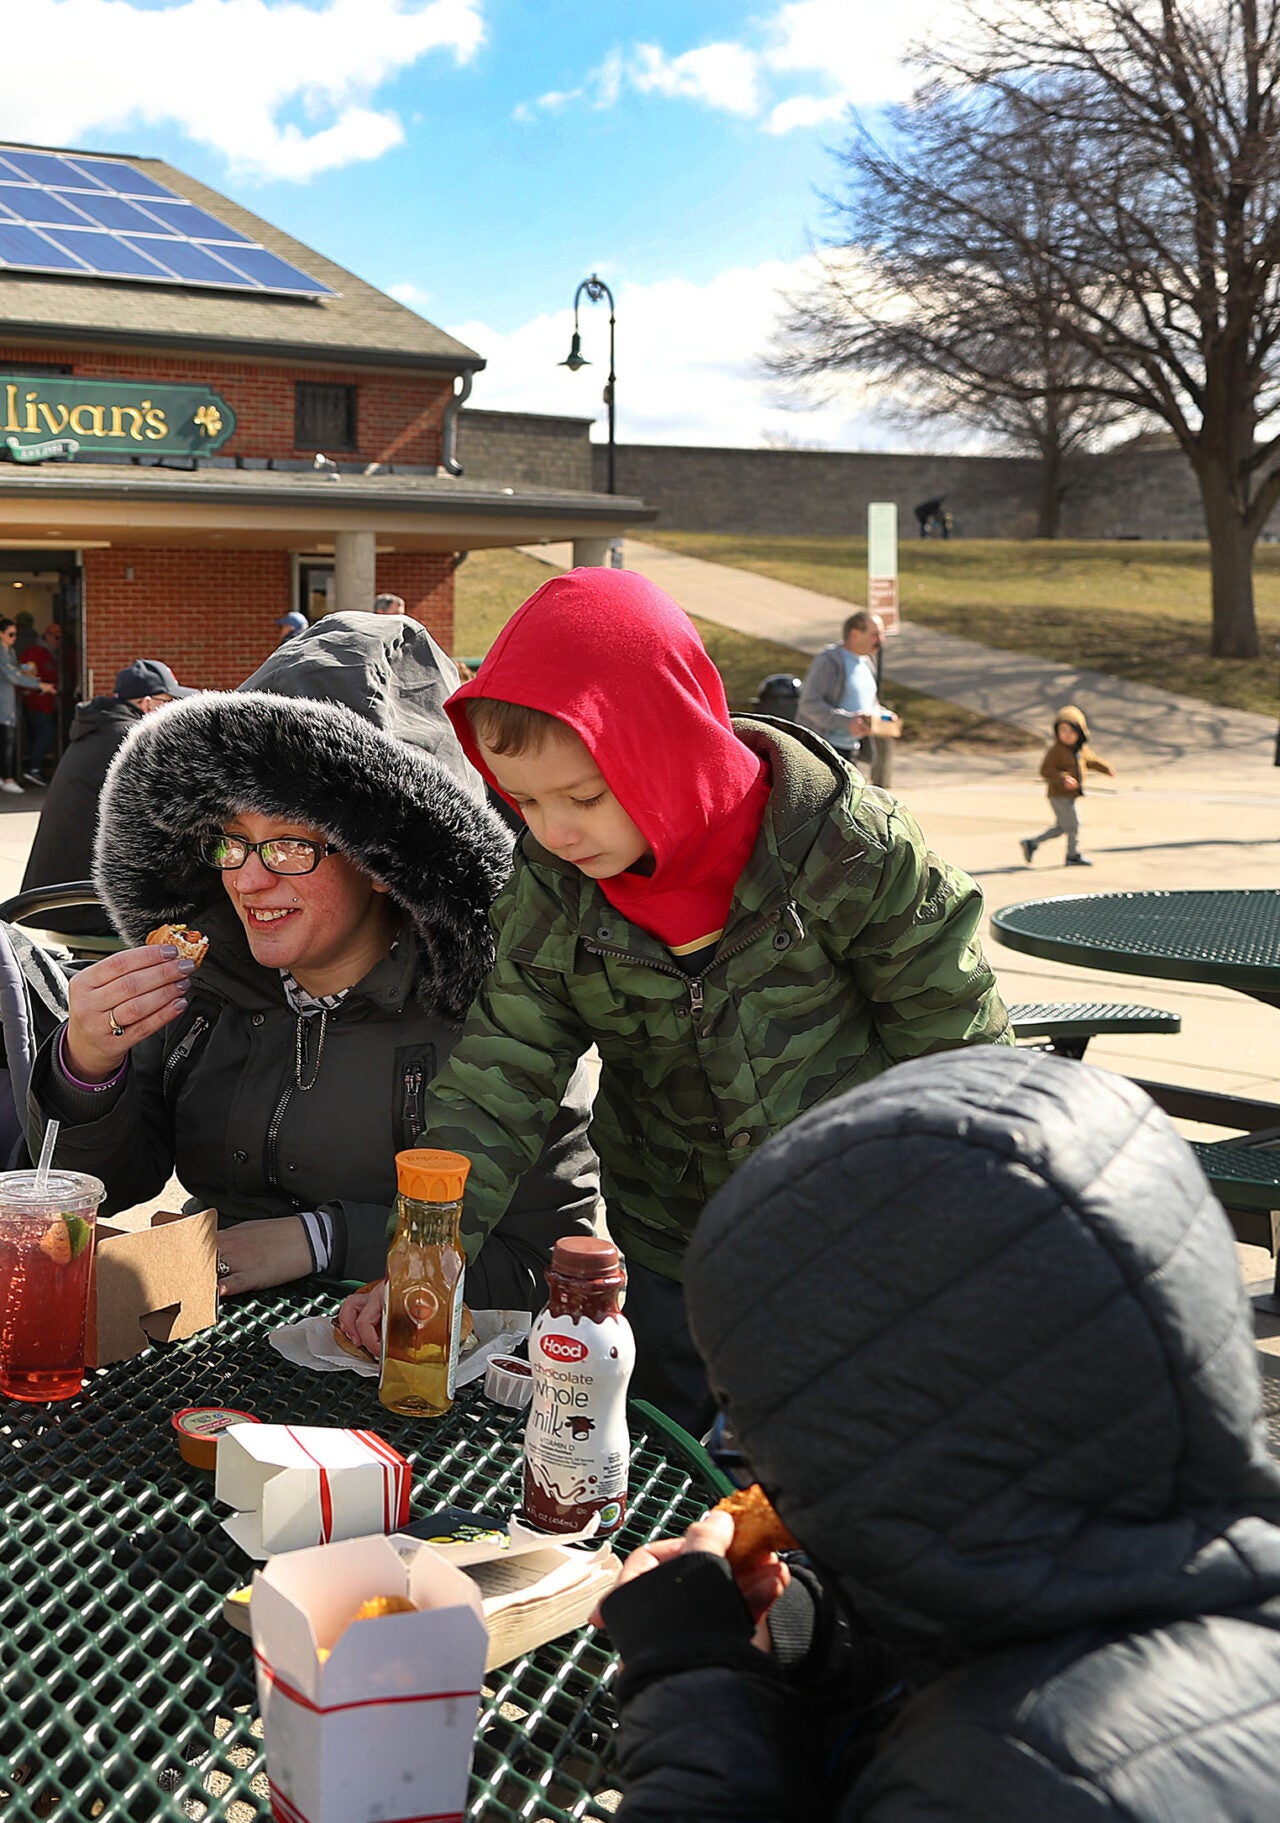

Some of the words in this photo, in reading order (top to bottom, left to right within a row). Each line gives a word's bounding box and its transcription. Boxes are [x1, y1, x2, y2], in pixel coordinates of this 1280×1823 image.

[543, 1337, 582, 1358] Hood
[533, 1363, 594, 1385] chocolate
[535, 1379, 589, 1408] whole
[533, 1403, 563, 1438] milk
